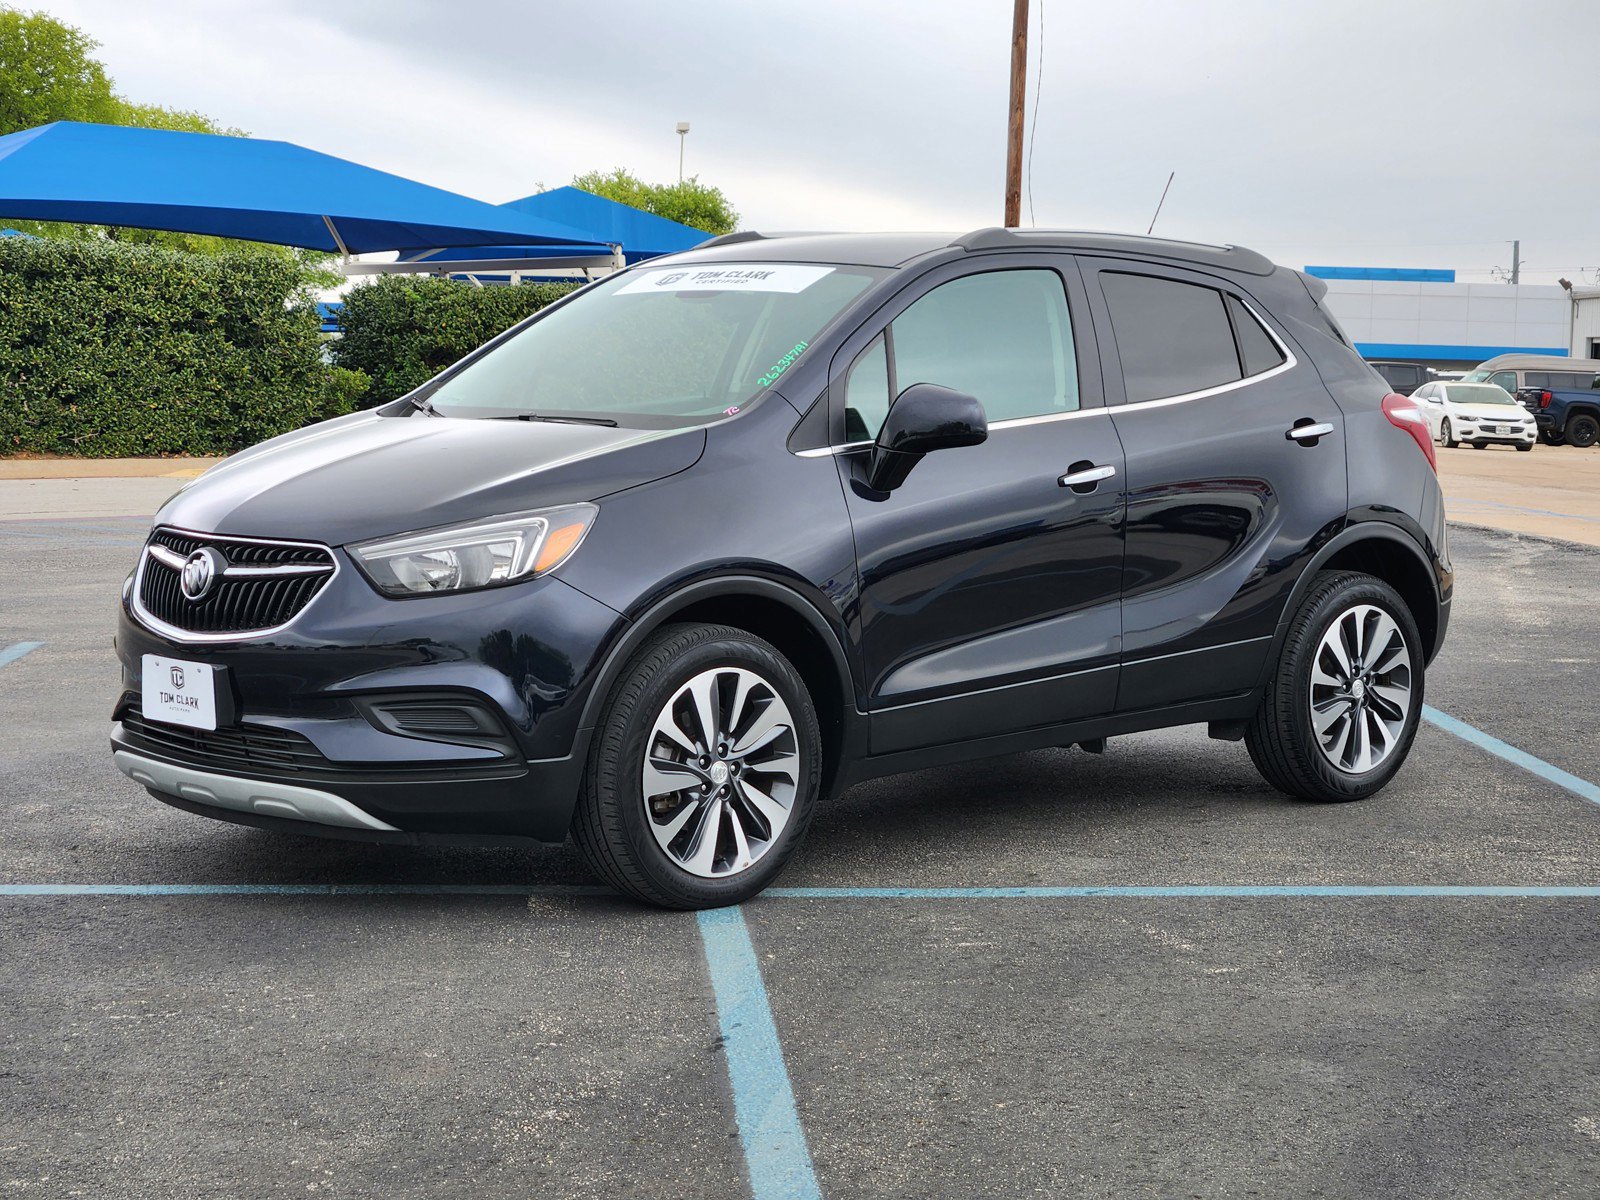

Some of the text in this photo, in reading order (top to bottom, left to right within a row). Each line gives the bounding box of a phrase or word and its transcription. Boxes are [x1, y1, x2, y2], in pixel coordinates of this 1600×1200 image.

[691, 270, 776, 280] TOM CLARK
[160, 692, 199, 710] TOM CLARK
